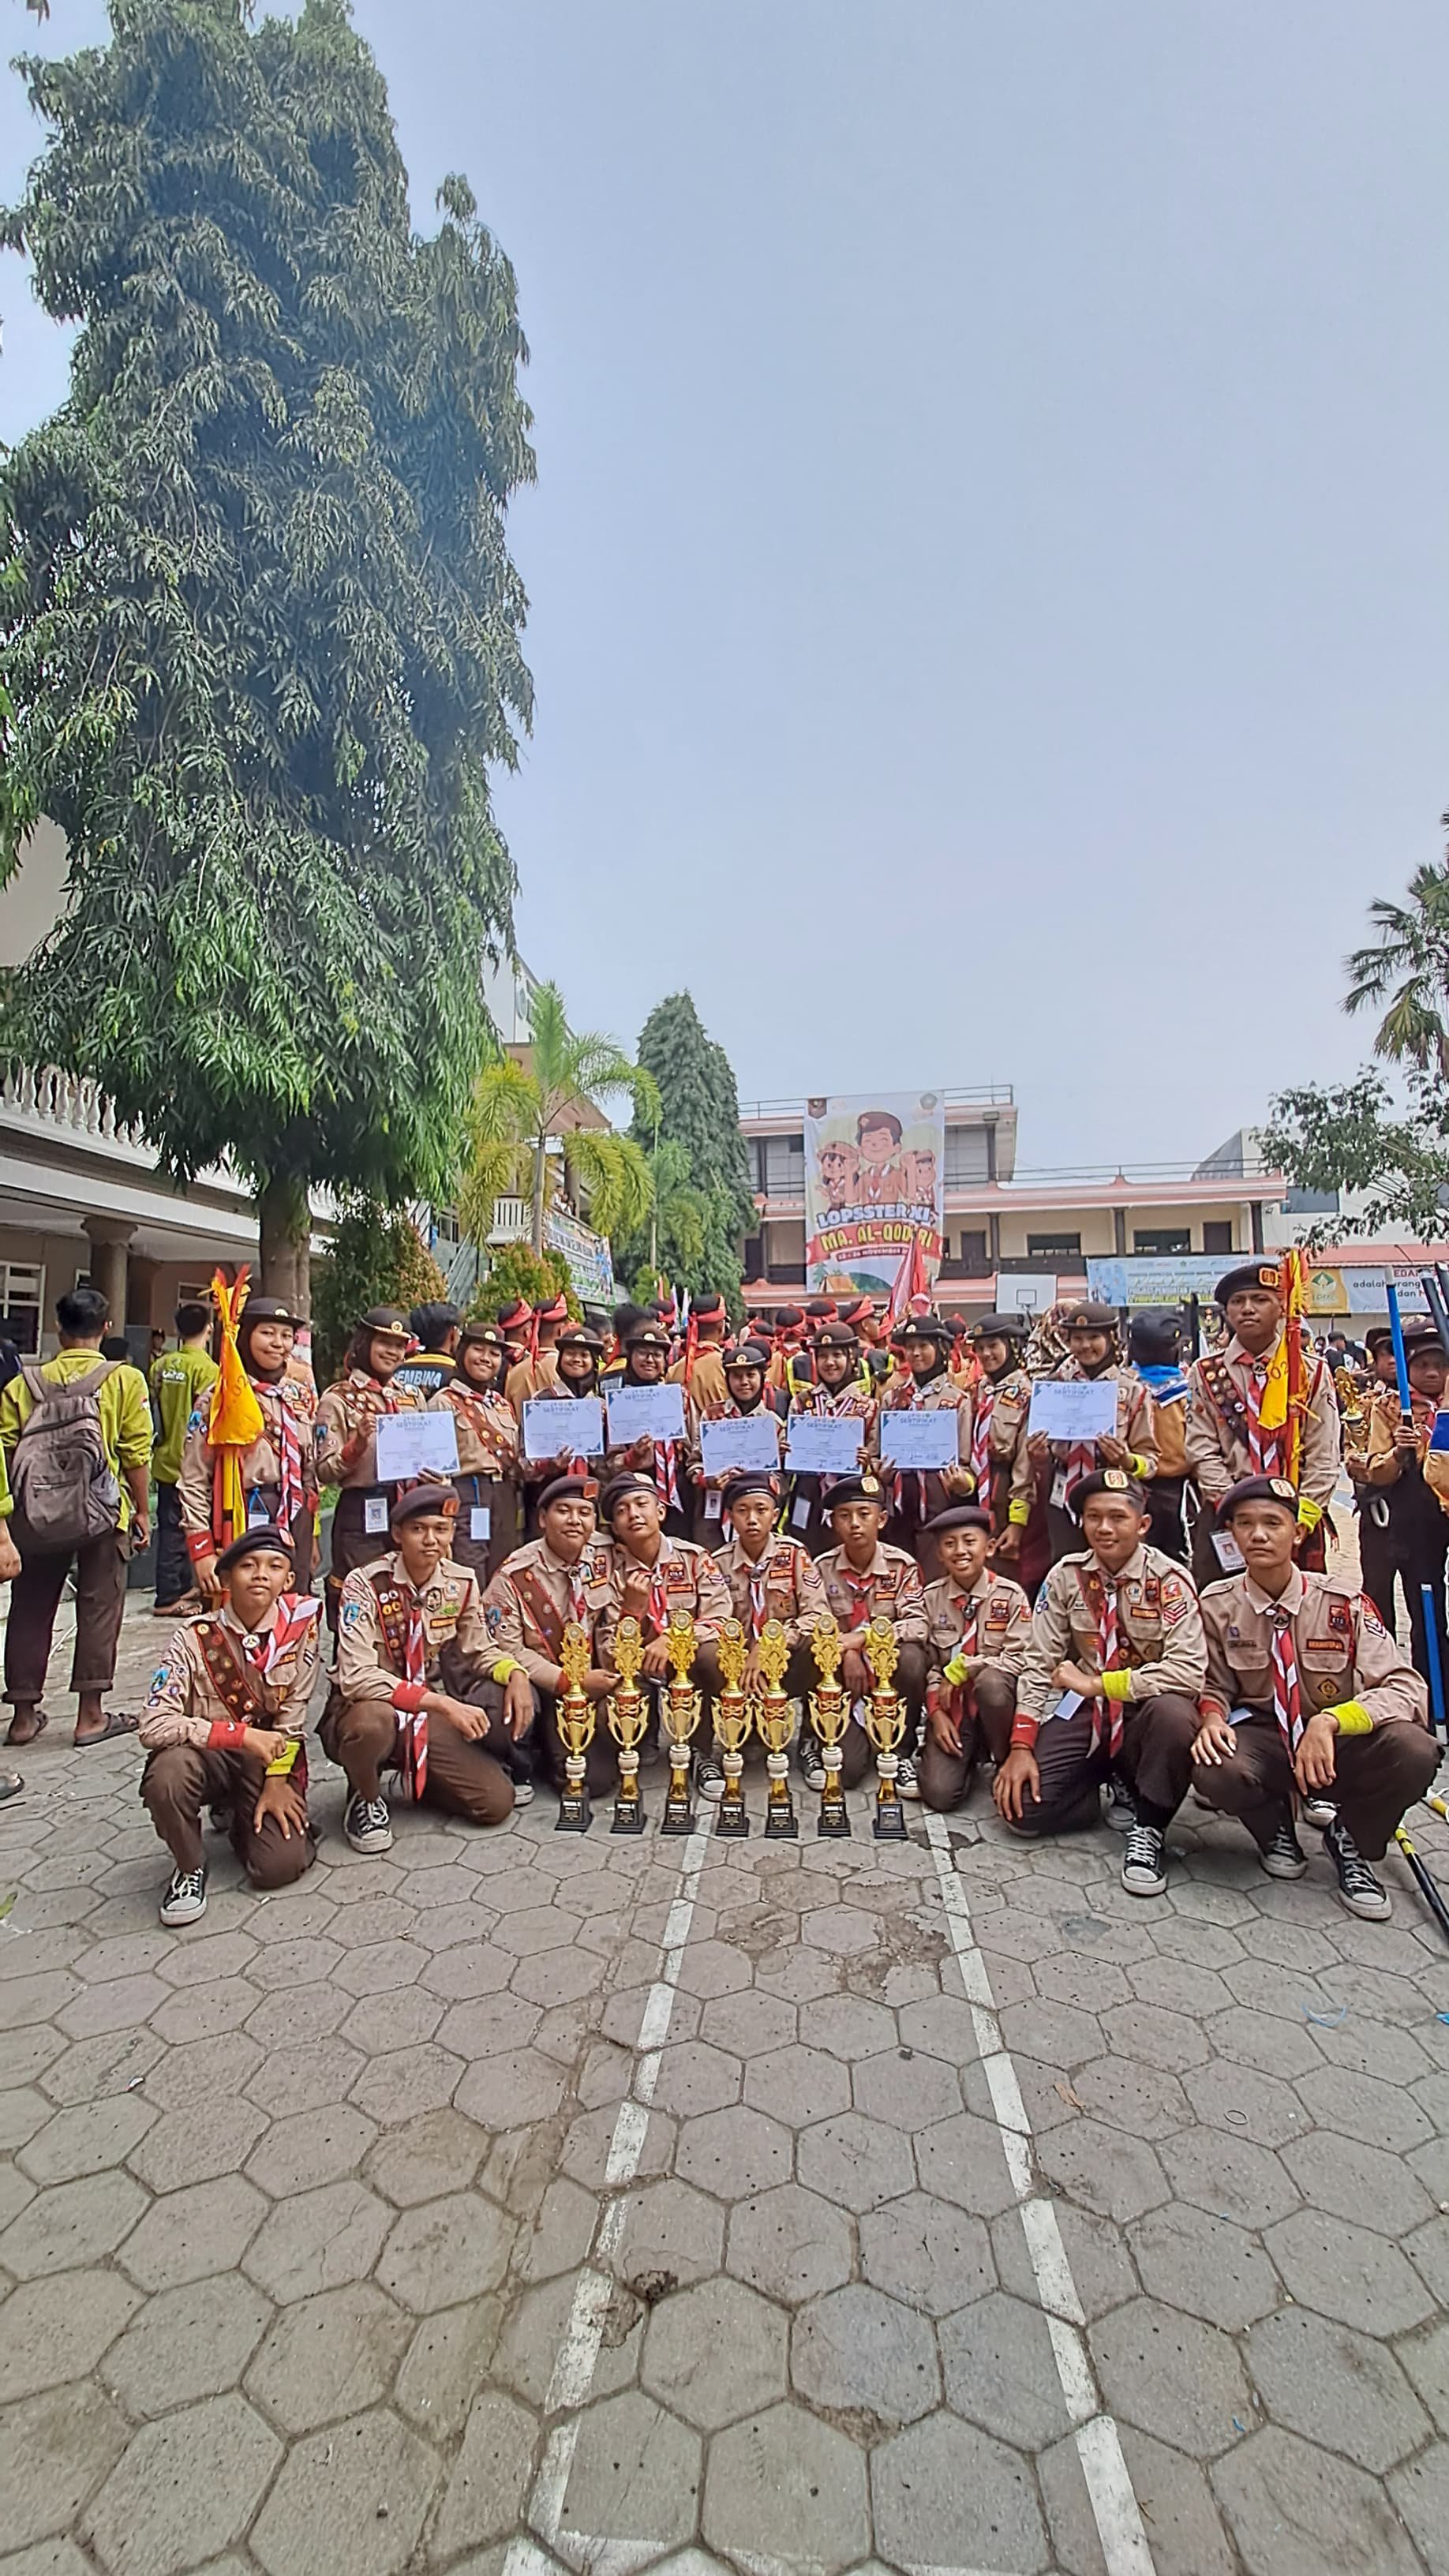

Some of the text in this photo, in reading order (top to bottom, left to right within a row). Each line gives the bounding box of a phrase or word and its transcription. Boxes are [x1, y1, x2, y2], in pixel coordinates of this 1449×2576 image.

[817, 1203, 931, 1228] LOPSSTER XI
[821, 1223, 933, 1252] MA. AL-QODRI
[1395, 1280, 1421, 1289] rang
